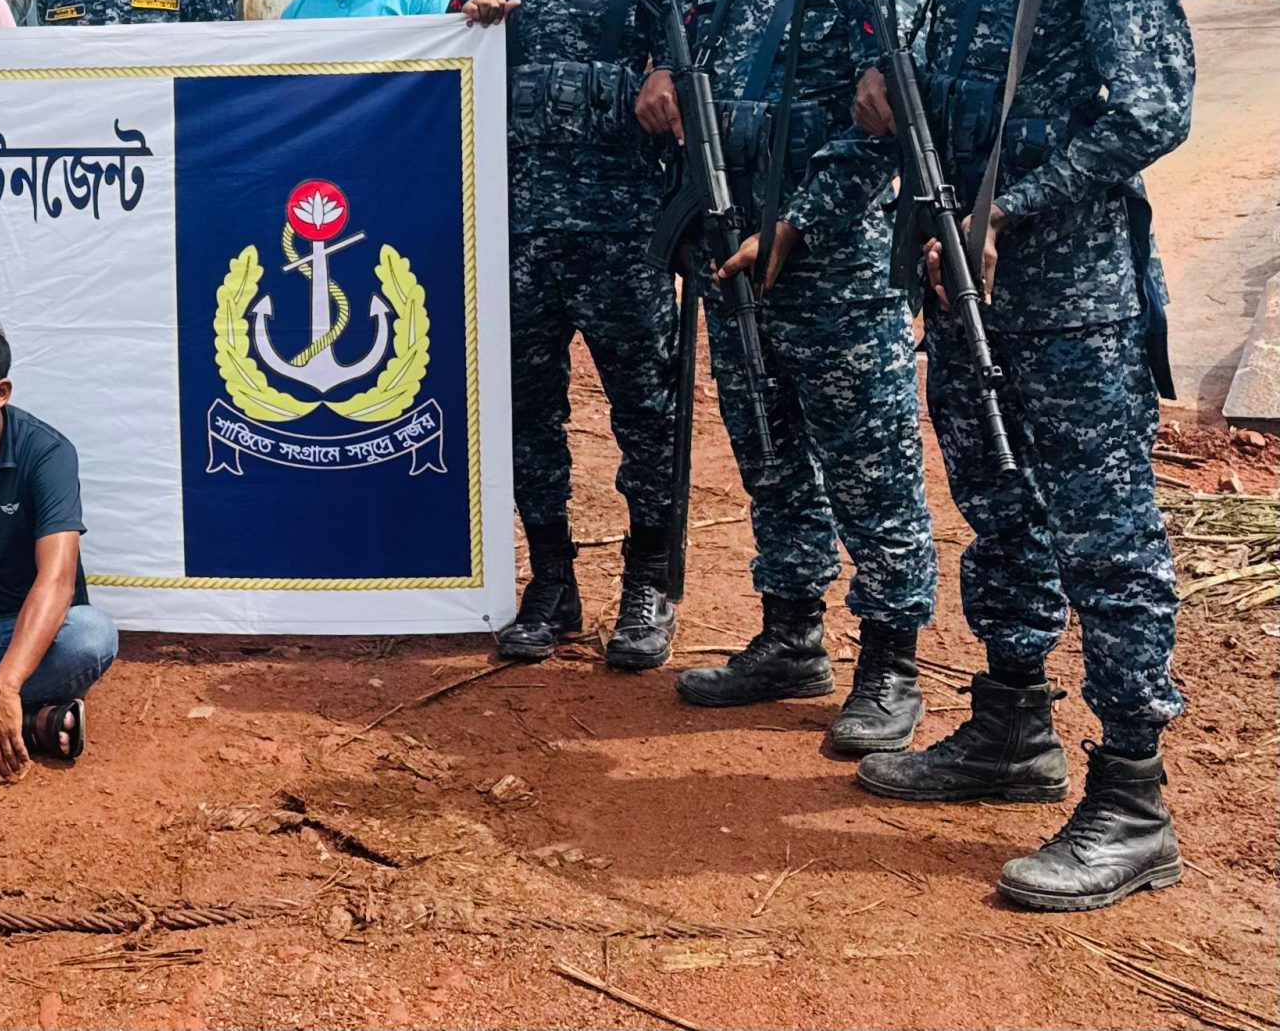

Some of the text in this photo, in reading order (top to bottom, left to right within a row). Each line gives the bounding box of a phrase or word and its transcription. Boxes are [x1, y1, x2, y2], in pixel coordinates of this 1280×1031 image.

[215, 413, 435, 463] শান্তিতে সংগ্রামে সমুদ্রে দুর্জয়
